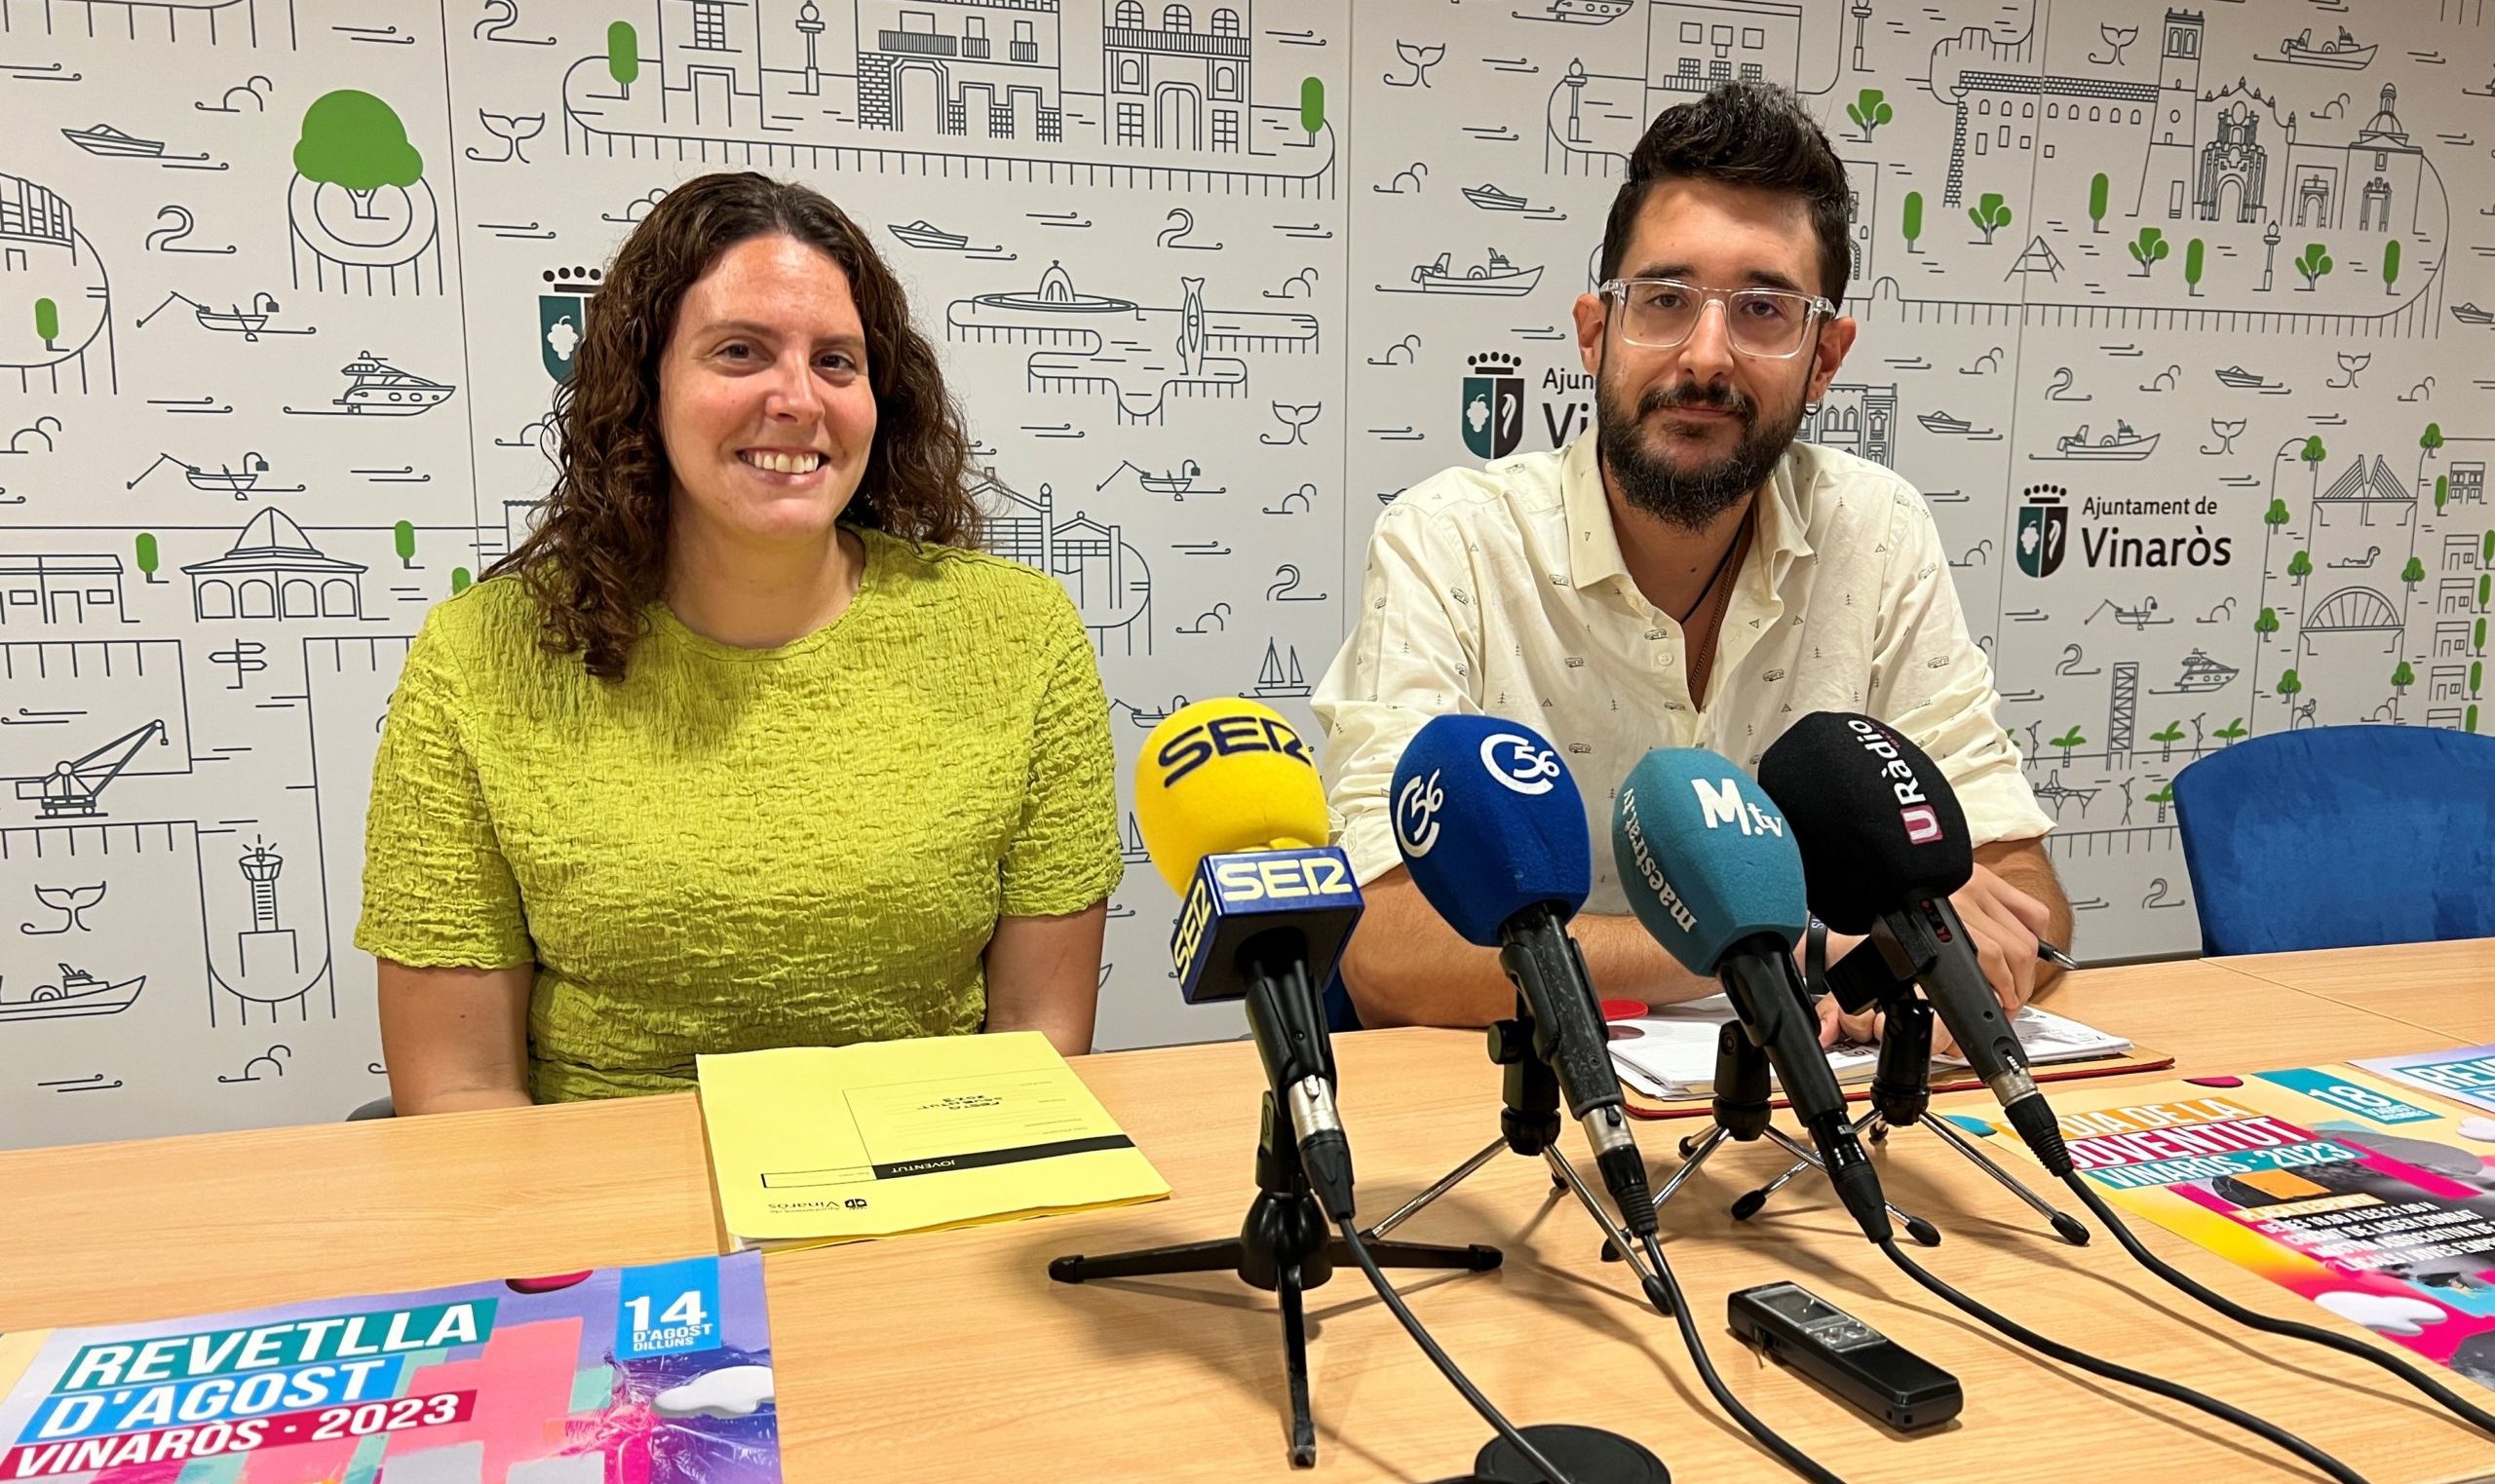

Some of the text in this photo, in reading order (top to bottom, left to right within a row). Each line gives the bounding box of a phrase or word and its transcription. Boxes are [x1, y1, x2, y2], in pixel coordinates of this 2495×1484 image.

[2082, 495, 2218, 520] Ajuntament de
[2081, 524, 2232, 568] Vinaròs
[1159, 716, 1312, 788] SER
[1215, 857, 1353, 901] SER
[1174, 878, 1211, 985] SER
[2118, 1104, 2185, 1126] DE
[2183, 1097, 2251, 1121] LA
[2309, 1085, 2393, 1110] 18
[891, 1160, 955, 1173] JOVENTUT
[2258, 1141, 2355, 1168] 2023
[625, 1290, 708, 1331] 14
[64, 1303, 478, 1390] REVETLLA
[633, 1323, 713, 1343] D'AGOST
[633, 1337, 694, 1351] DILLUNS
[37, 1359, 385, 1439] D'AGOST
[14, 1395, 459, 1478] VINARÒS 2023
